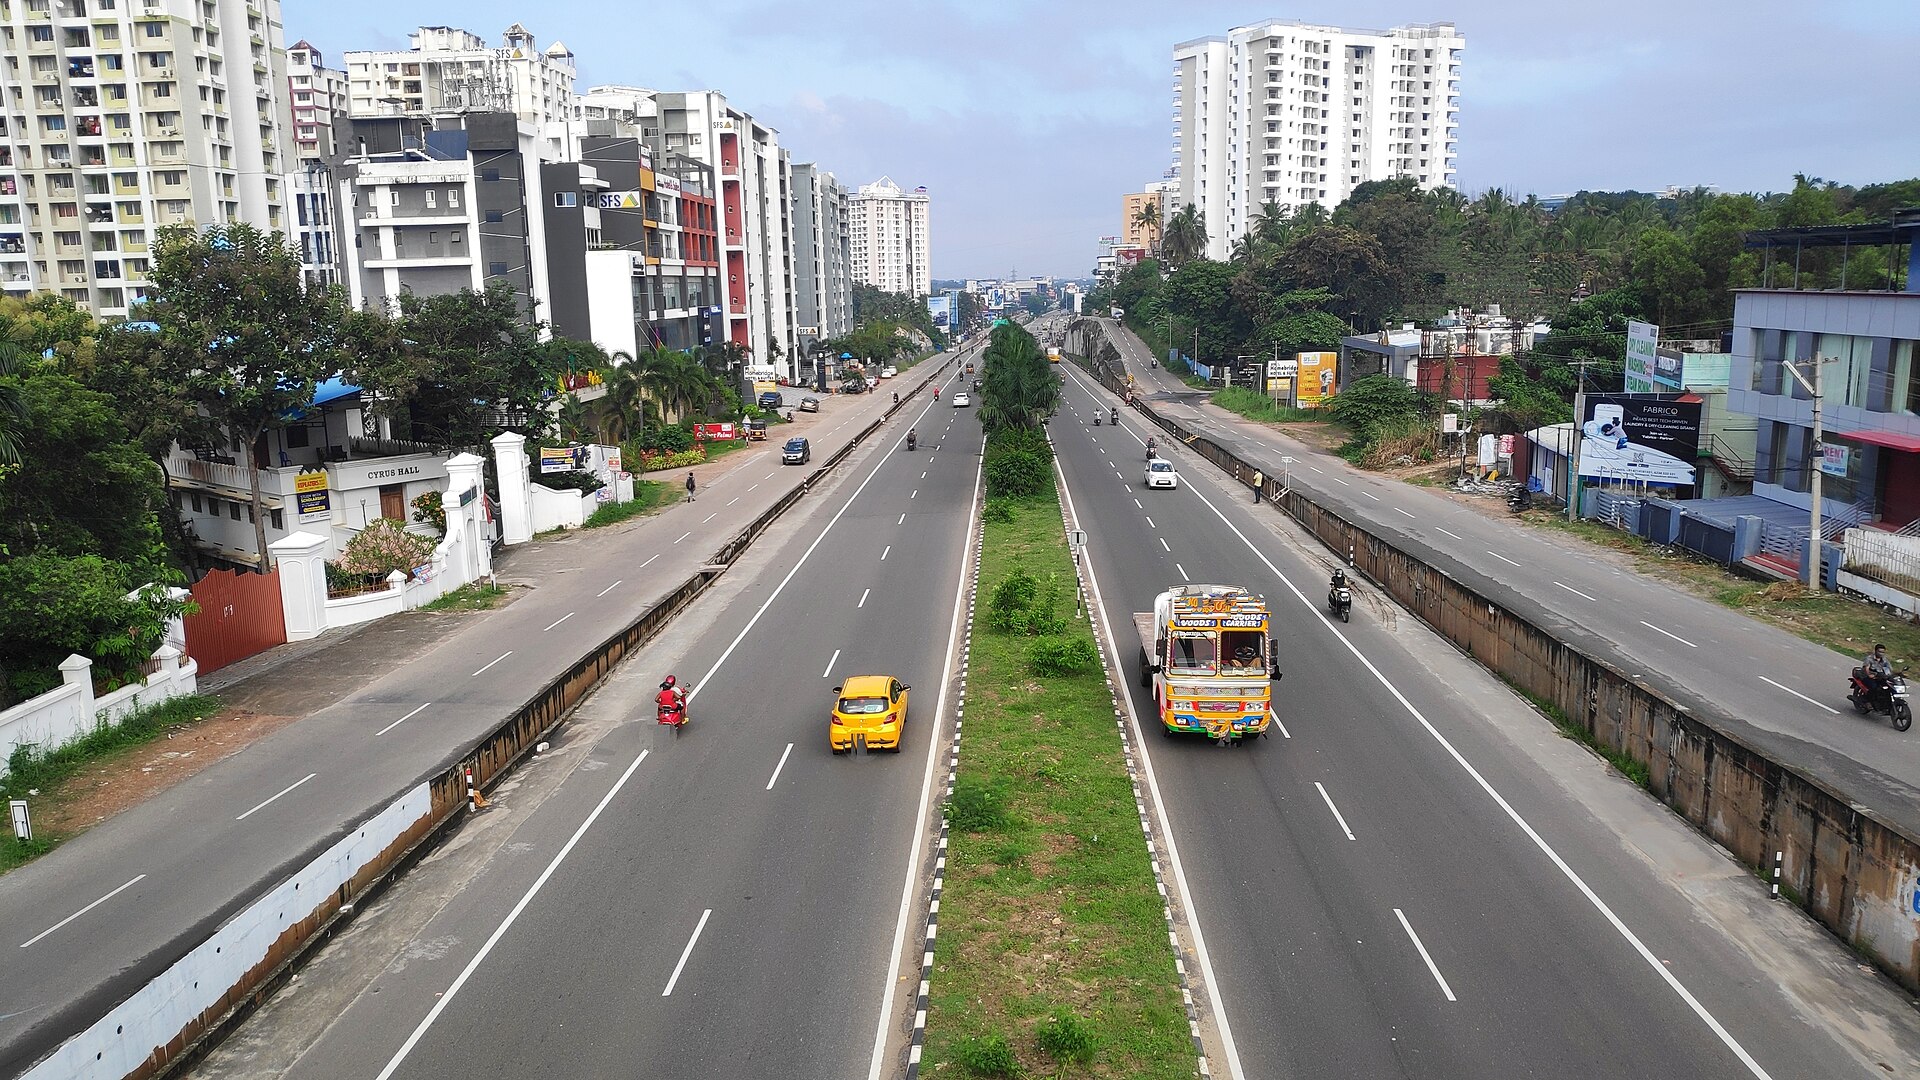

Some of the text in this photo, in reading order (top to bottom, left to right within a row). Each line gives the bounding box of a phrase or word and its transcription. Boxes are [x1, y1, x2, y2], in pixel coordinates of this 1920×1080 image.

[495, 48, 511, 59] SFS
[712, 121, 724, 129] SFS
[600, 194, 622, 208] SFS
[1642, 405, 1679, 415] FABRICO
[367, 466, 420, 480] CYRUS HALL
[1225, 619, 1257, 627] CARRIER
